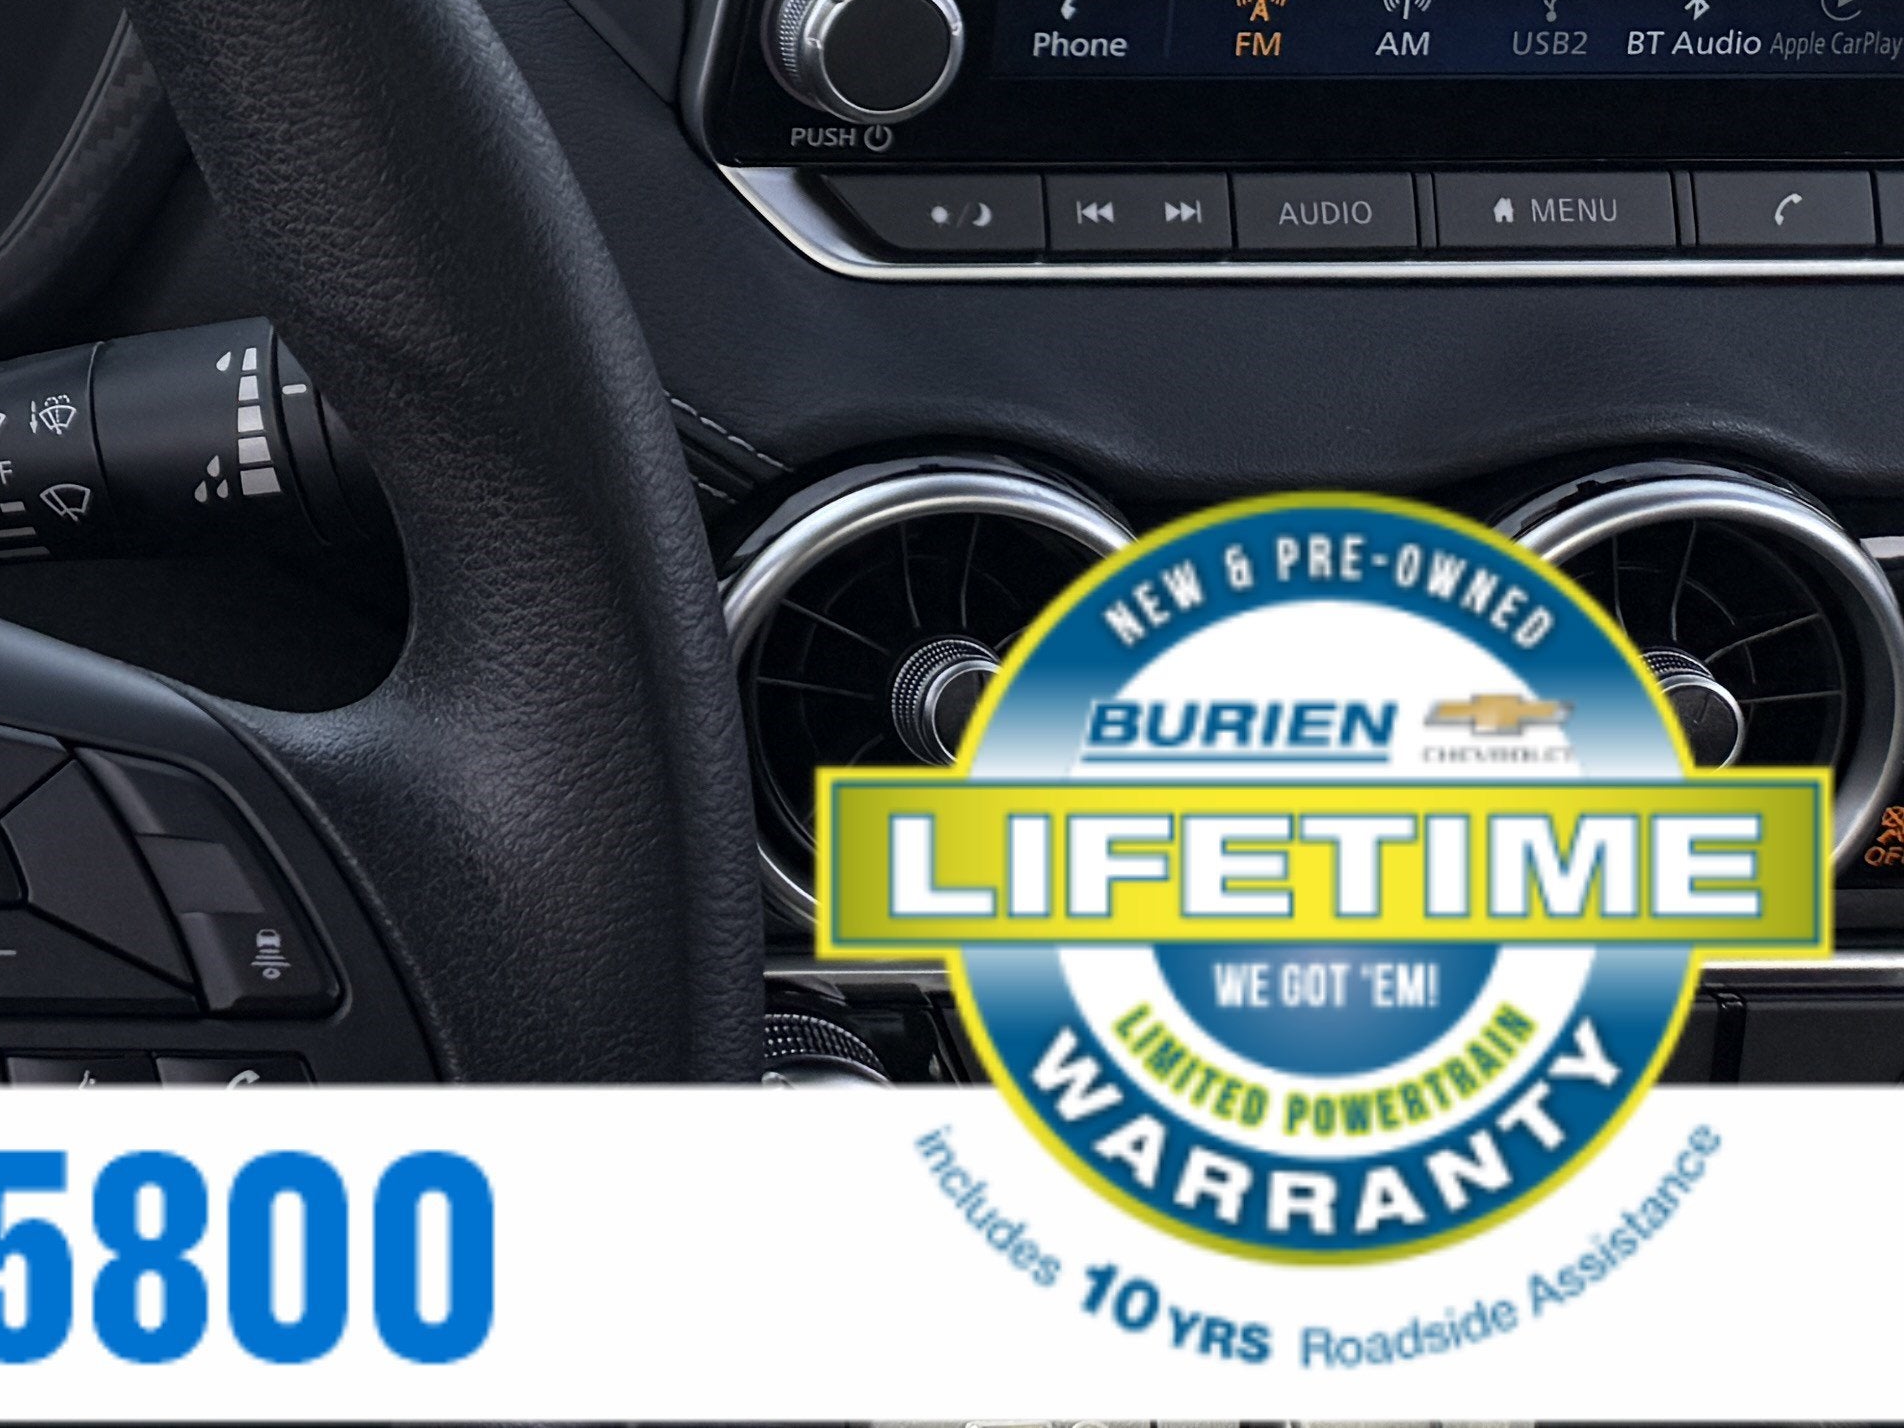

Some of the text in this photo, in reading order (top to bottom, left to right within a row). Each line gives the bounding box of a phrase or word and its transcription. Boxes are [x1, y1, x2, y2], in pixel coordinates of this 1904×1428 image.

[1033, 31, 1128, 58] Phone
[1235, 31, 1281, 56] FM
[1375, 31, 1430, 56] AM
[1512, 30, 1588, 55] USB2
[1626, 30, 1762, 55] BT Audio
[1769, 31, 1903, 61] Apple CarPlay
[791, 127, 856, 147] PUSH
[1279, 200, 1372, 226] AUDIO
[1531, 198, 1618, 223] MENU
[1864, 845, 1904, 867] OF
